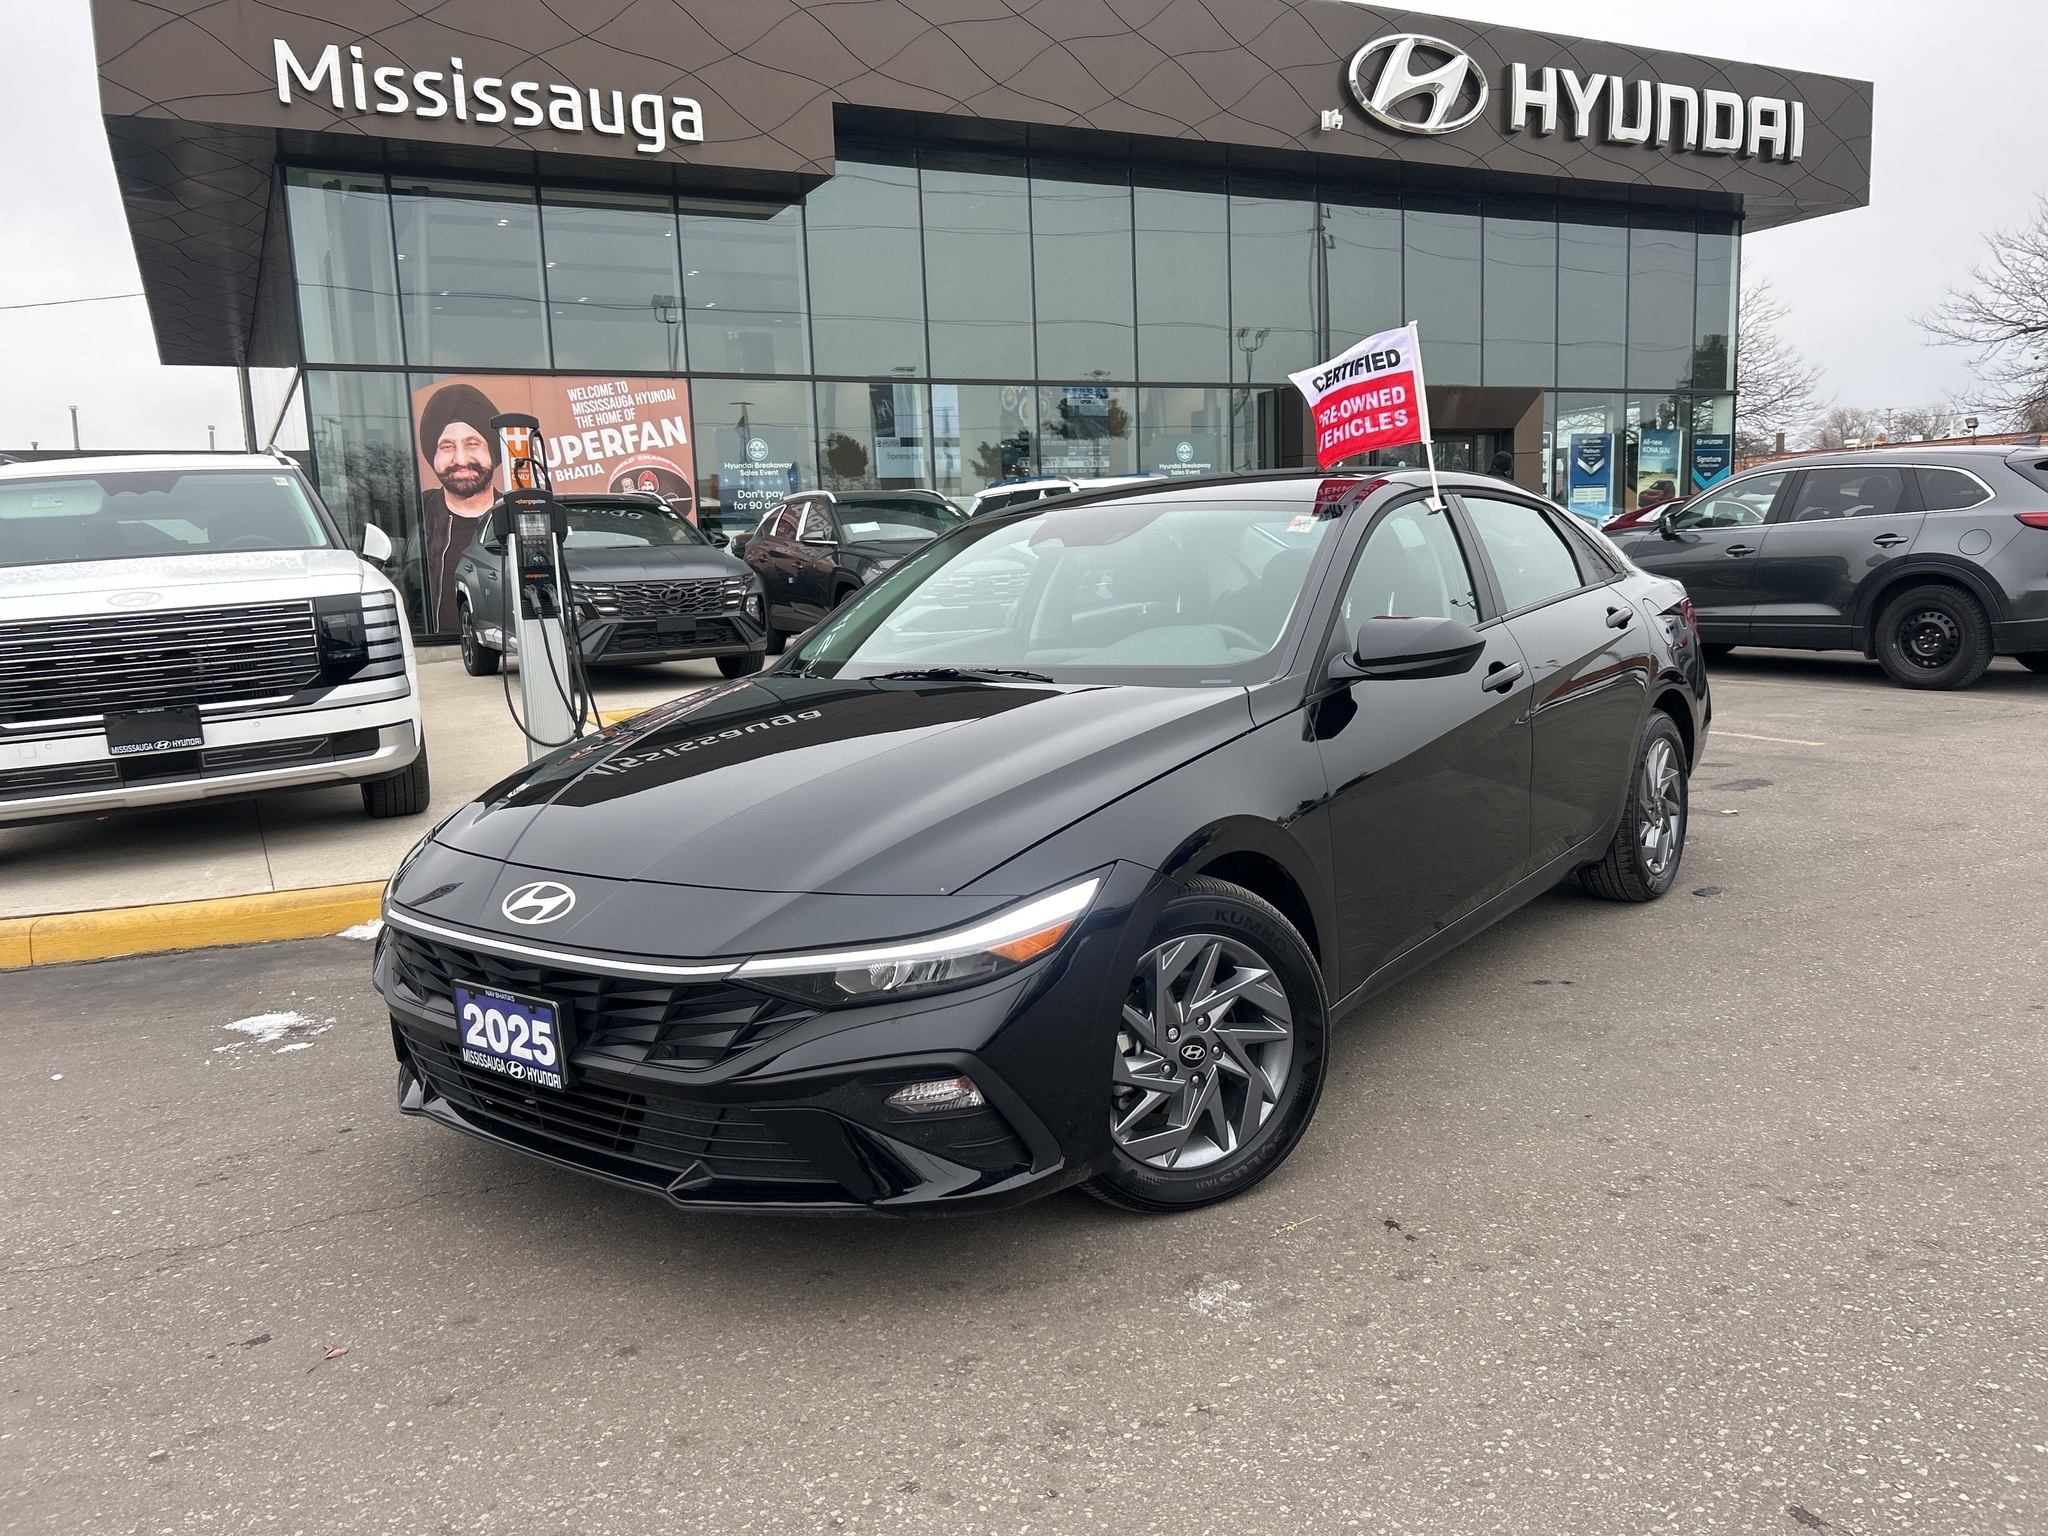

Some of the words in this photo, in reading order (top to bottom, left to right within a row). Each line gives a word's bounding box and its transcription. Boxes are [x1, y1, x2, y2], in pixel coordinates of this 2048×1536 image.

[273, 38, 704, 154] Mississauga
[1510, 62, 1805, 161] HYUNDAI
[1312, 349, 1401, 393] CERTIFIED
[567, 383, 614, 401] WELCOME
[615, 380, 629, 394] TO
[571, 394, 635, 416] MISSISSAUGA
[636, 388, 677, 406] HYUNDAI
[574, 415, 595, 429] THE
[595, 411, 624, 426] HOME
[624, 407, 636, 421] OF
[533, 416, 688, 469] UPERFAN
[1642, 446, 1659, 454] KONA
[555, 462, 605, 482] BHATIA
[724, 462, 754, 470] Hyundai
[755, 462, 793, 470] Breakaway
[733, 501, 748, 510] for
[749, 501, 762, 510] 90
[737, 490, 765, 499] Don't
[766, 491, 784, 501] pay
[111, 743, 154, 754] MISSISSAUGA
[172, 737, 202, 747] HYUNDAI
[1214, 908, 1286, 952] KUMHO
[463, 1003, 556, 1066] 2025
[462, 1047, 507, 1074] MISSISSAUGA
[526, 1067, 562, 1089] HYUNDAI
